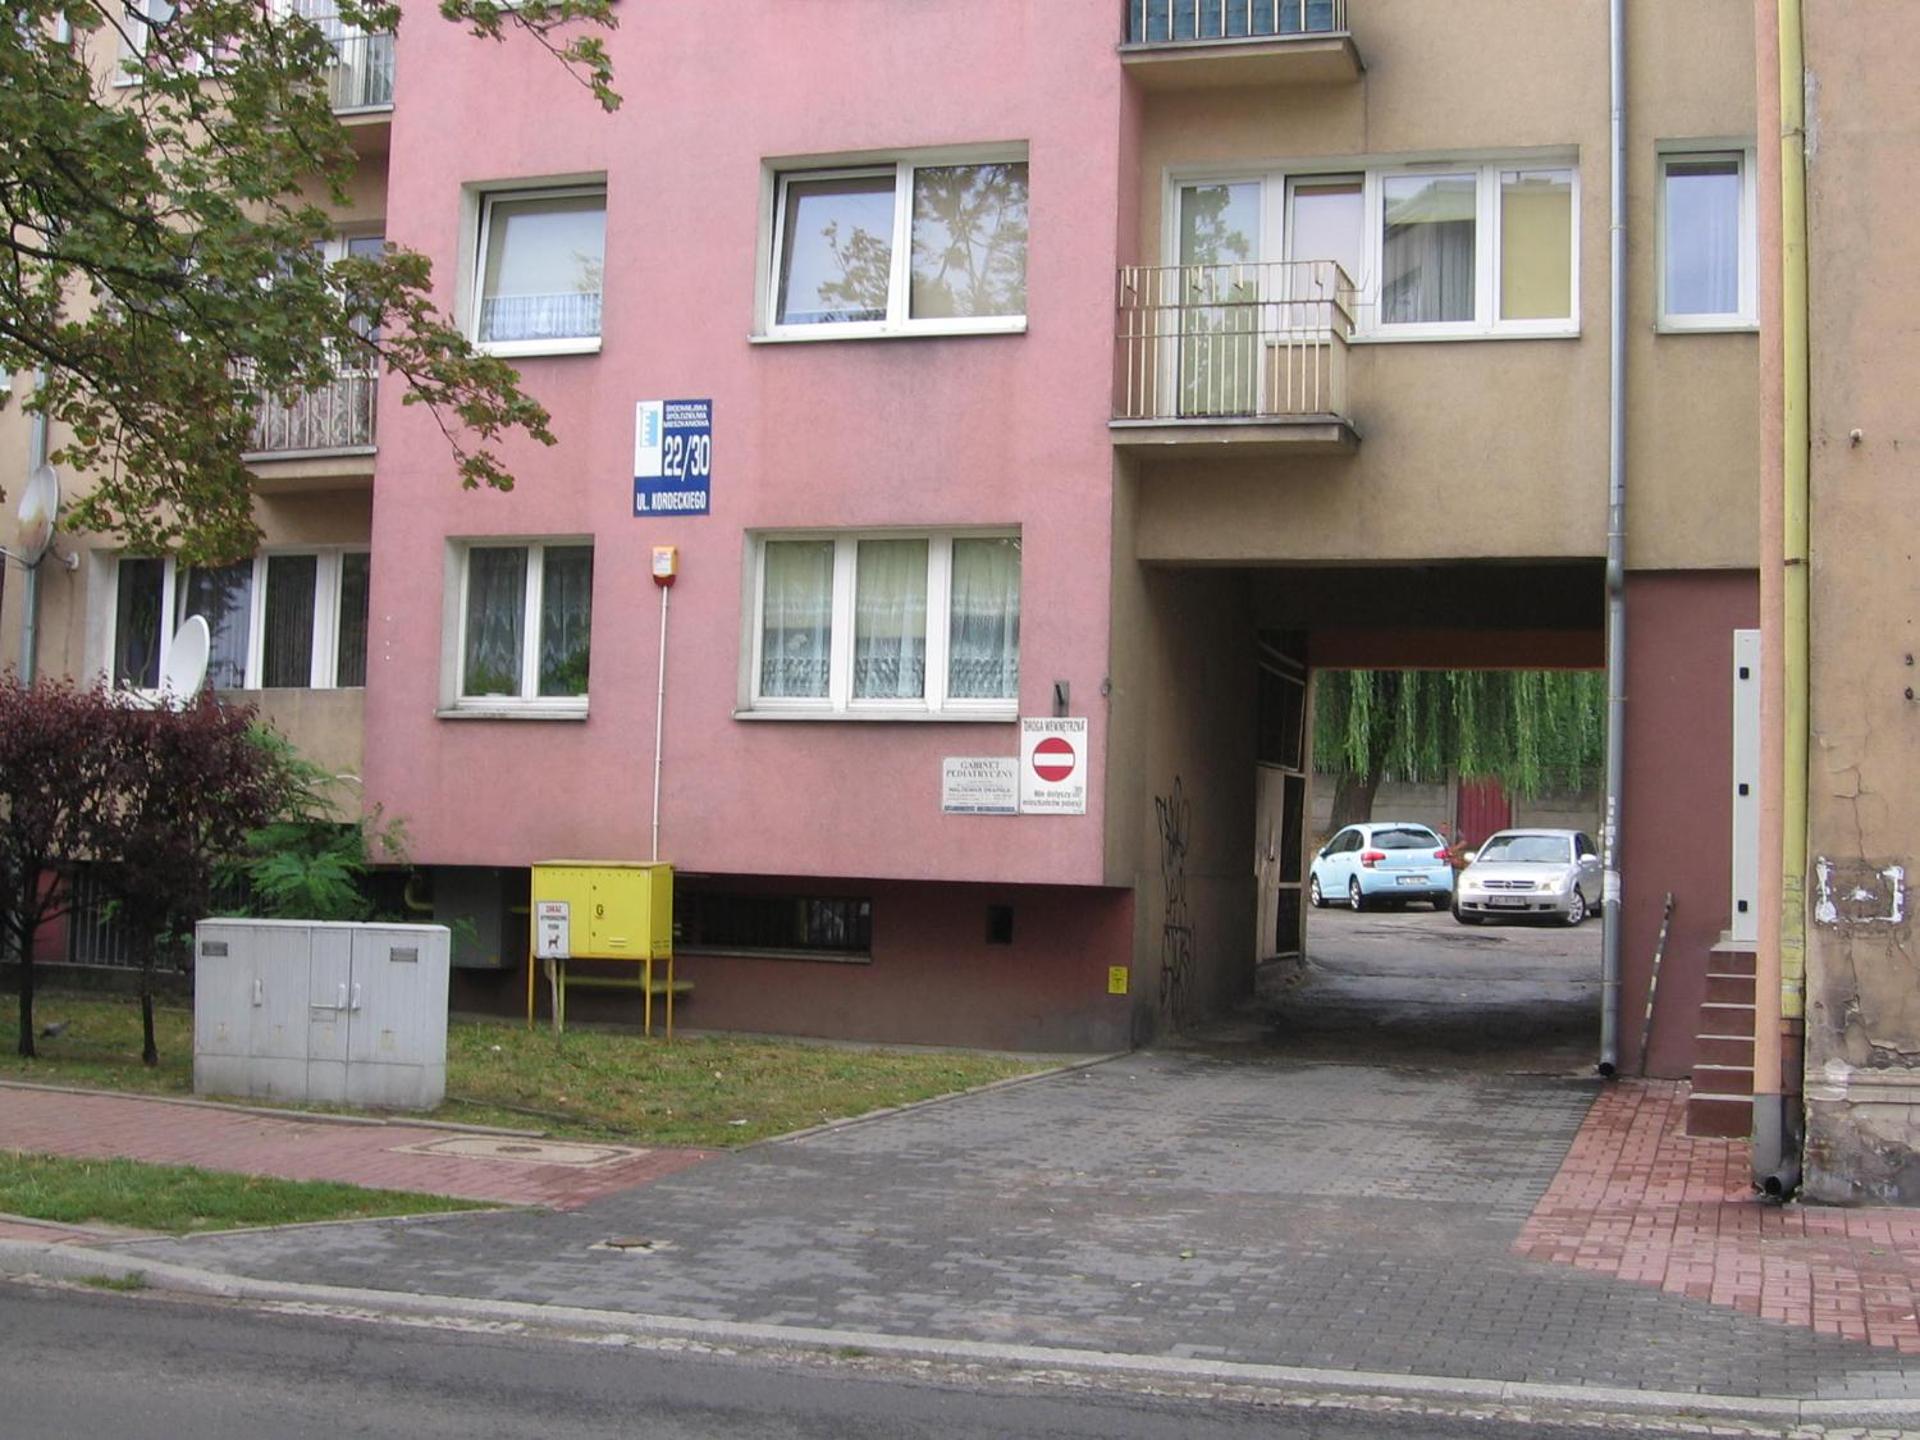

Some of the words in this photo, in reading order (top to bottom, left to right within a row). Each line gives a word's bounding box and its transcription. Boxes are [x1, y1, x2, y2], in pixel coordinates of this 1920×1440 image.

[664, 434, 710, 482] 22/30
[636, 492, 650, 511] UL.
[651, 490, 707, 510] KORDECKIEGO
[960, 760, 1000, 769] GABINET
[946, 769, 1013, 778] PEDIATRYCZNY
[596, 904, 604, 916] G
